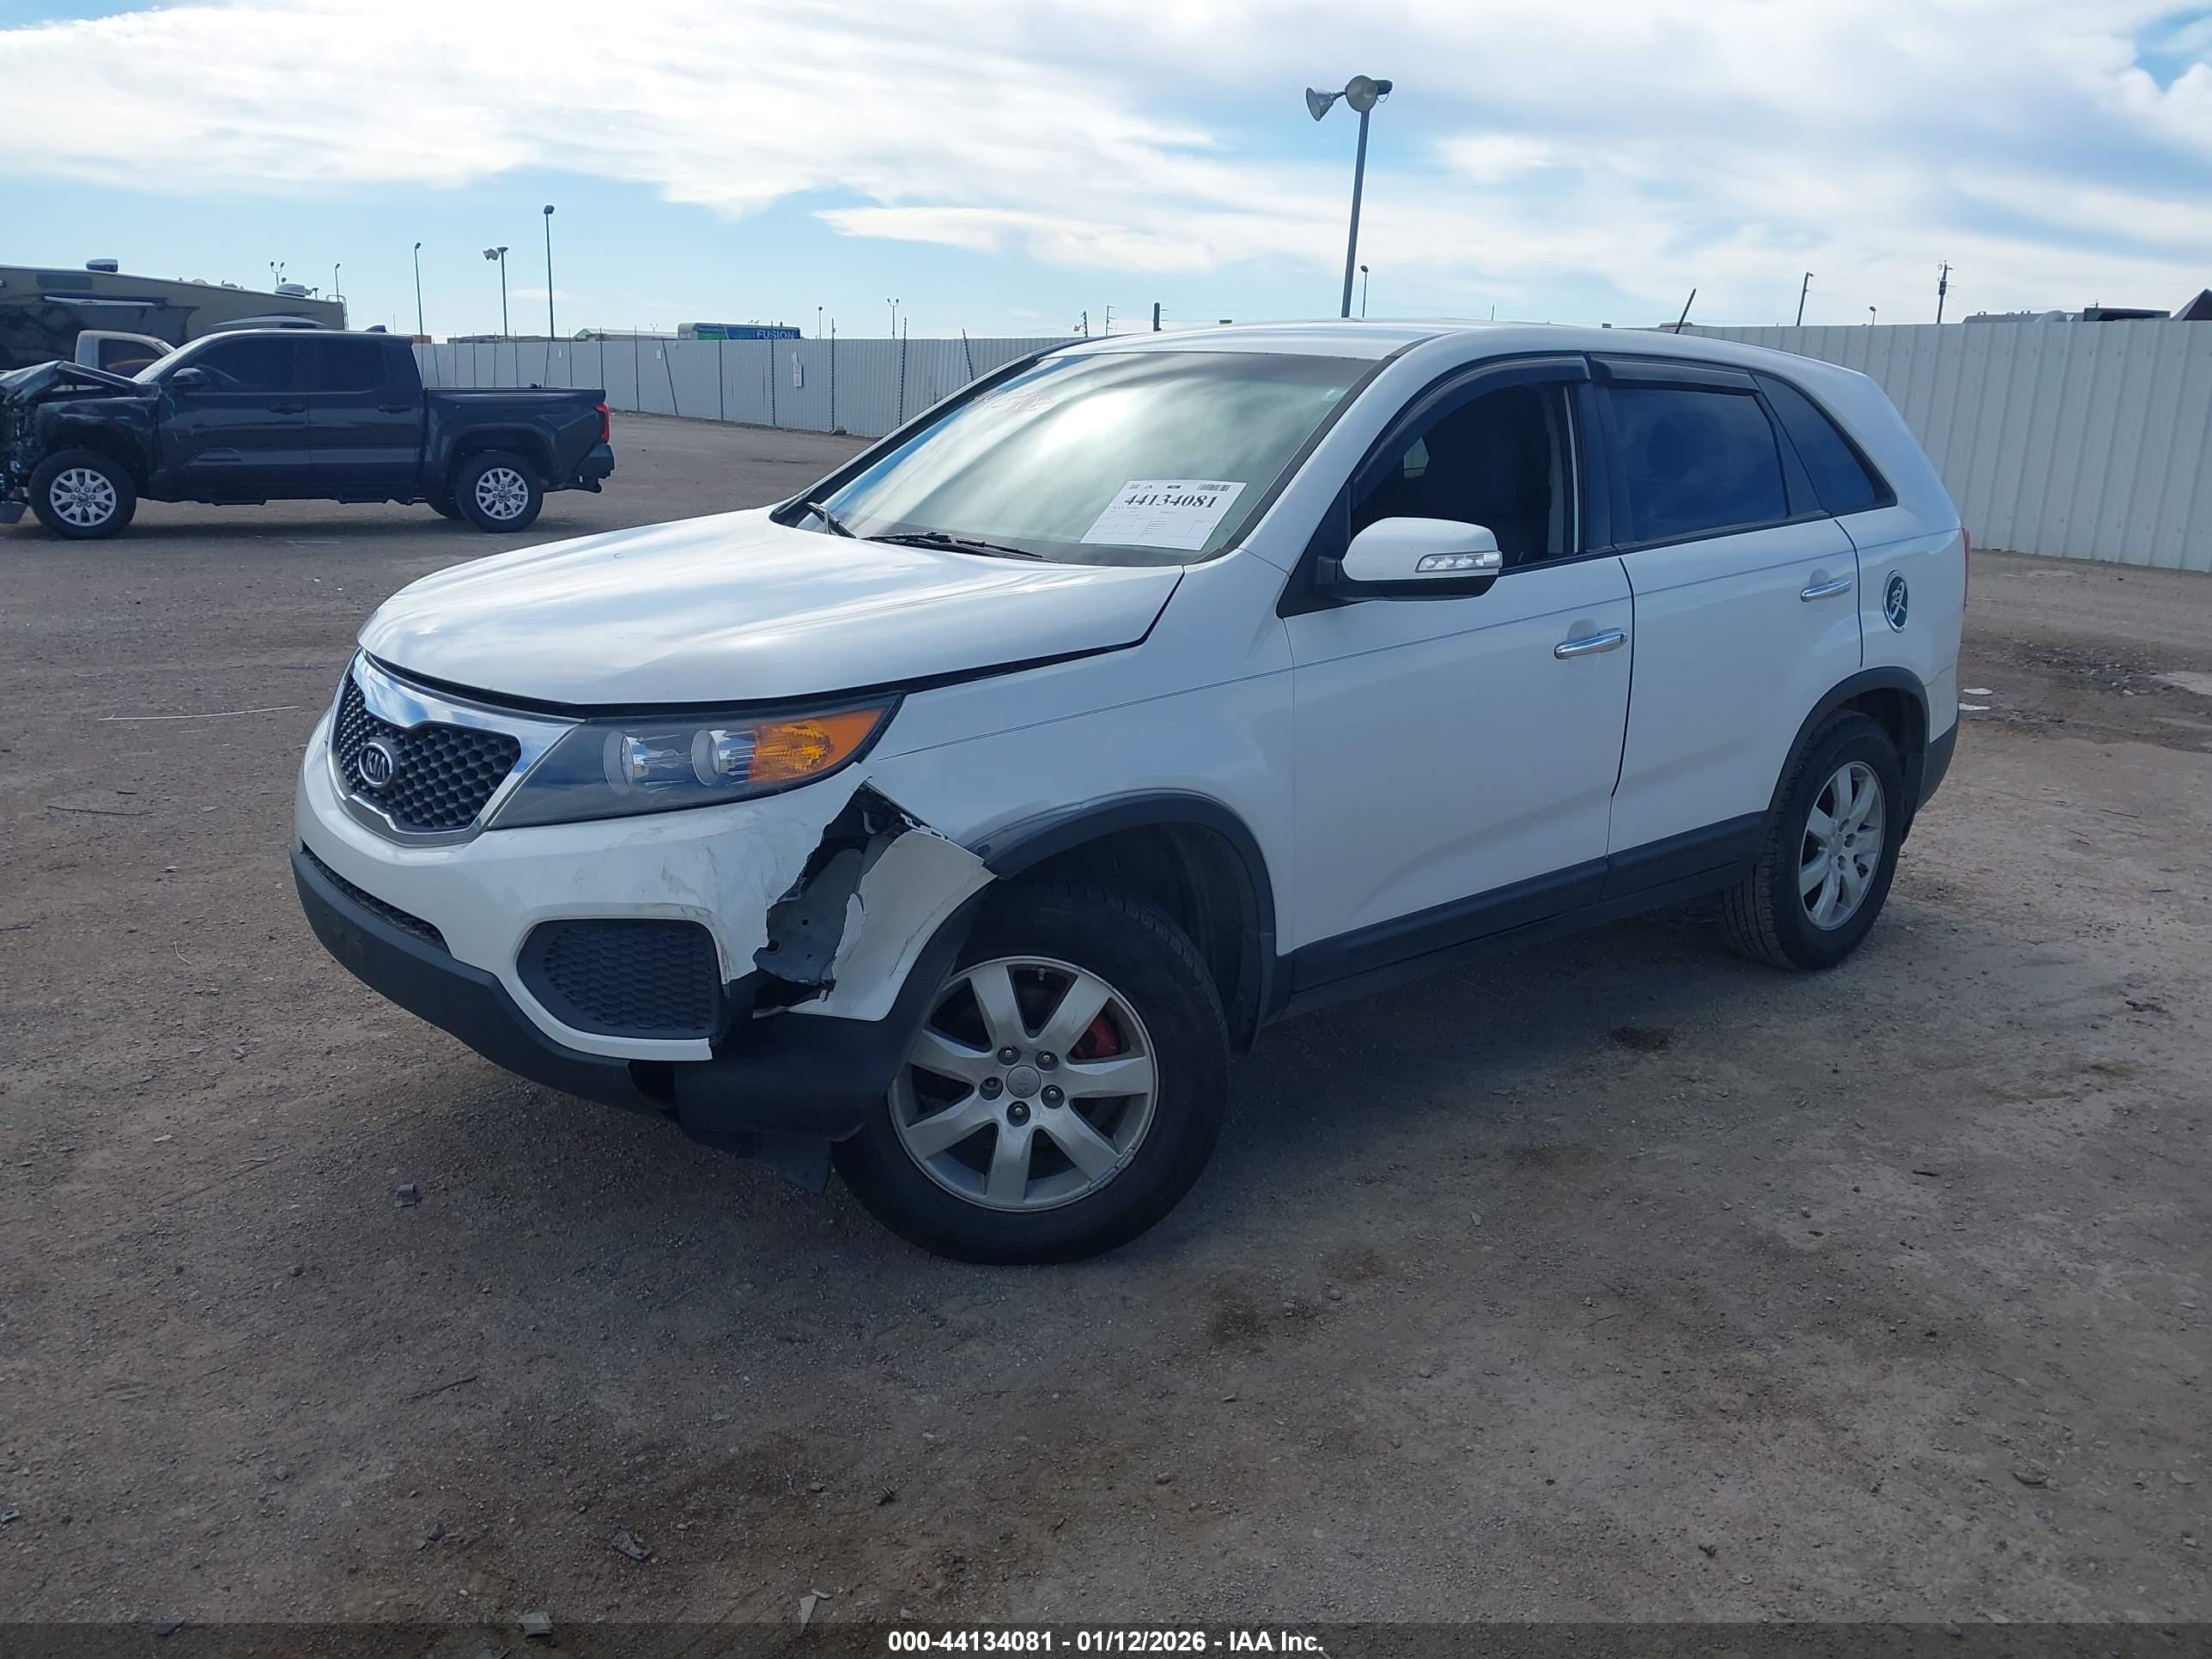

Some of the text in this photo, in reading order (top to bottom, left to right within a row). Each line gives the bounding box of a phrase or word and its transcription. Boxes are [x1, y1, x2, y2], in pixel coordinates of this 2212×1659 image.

[757, 329, 795, 339] FUSION
[1124, 493, 1218, 508] 44134081
[365, 750, 386, 781] KIA
